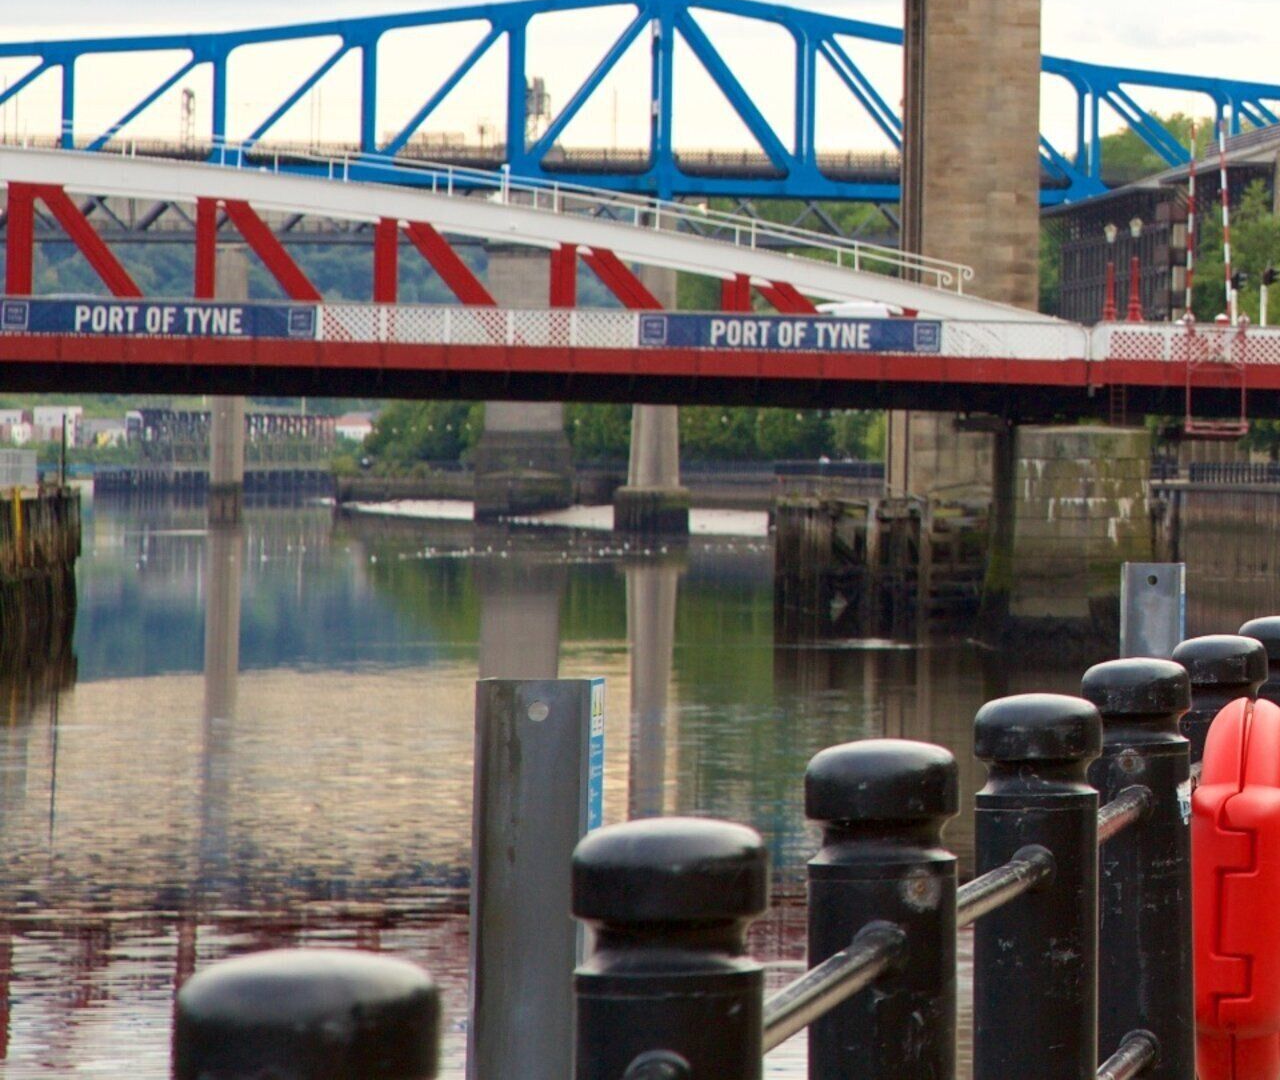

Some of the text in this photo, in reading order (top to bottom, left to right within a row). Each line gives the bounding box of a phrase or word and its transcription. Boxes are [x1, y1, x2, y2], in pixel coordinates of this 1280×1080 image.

[74, 304, 243, 335] PORT OF TYNE
[710, 320, 871, 349] PORT OF TYNE
